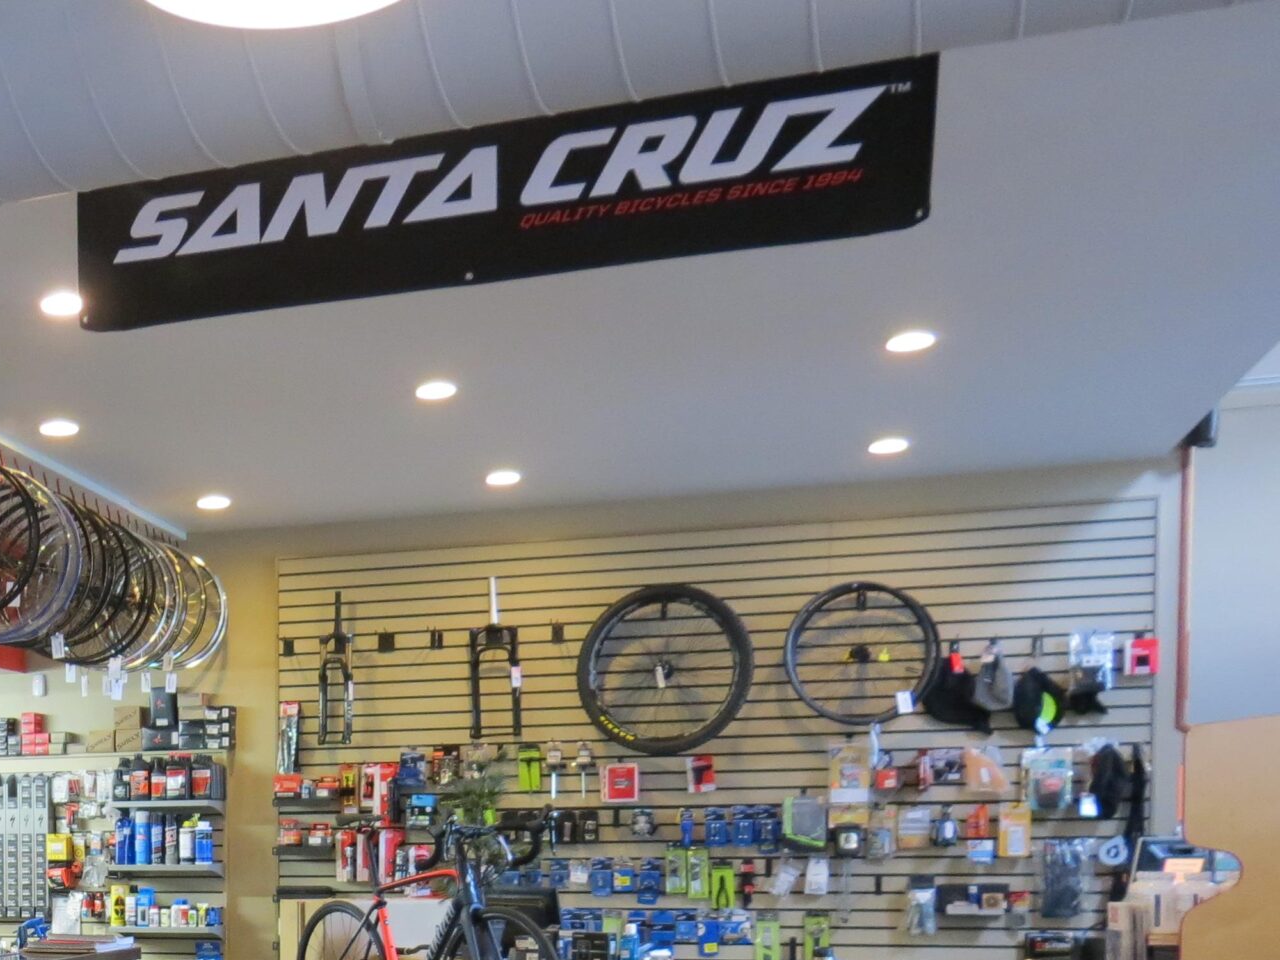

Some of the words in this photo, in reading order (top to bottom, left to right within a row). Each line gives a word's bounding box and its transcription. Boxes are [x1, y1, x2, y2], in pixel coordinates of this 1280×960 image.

[113, 145, 498, 265] SANTA
[520, 86, 888, 207] CRUZ
[520, 204, 610, 230] QUALITY
[614, 187, 721, 216] BICYCLES
[725, 177, 796, 201] SINCE
